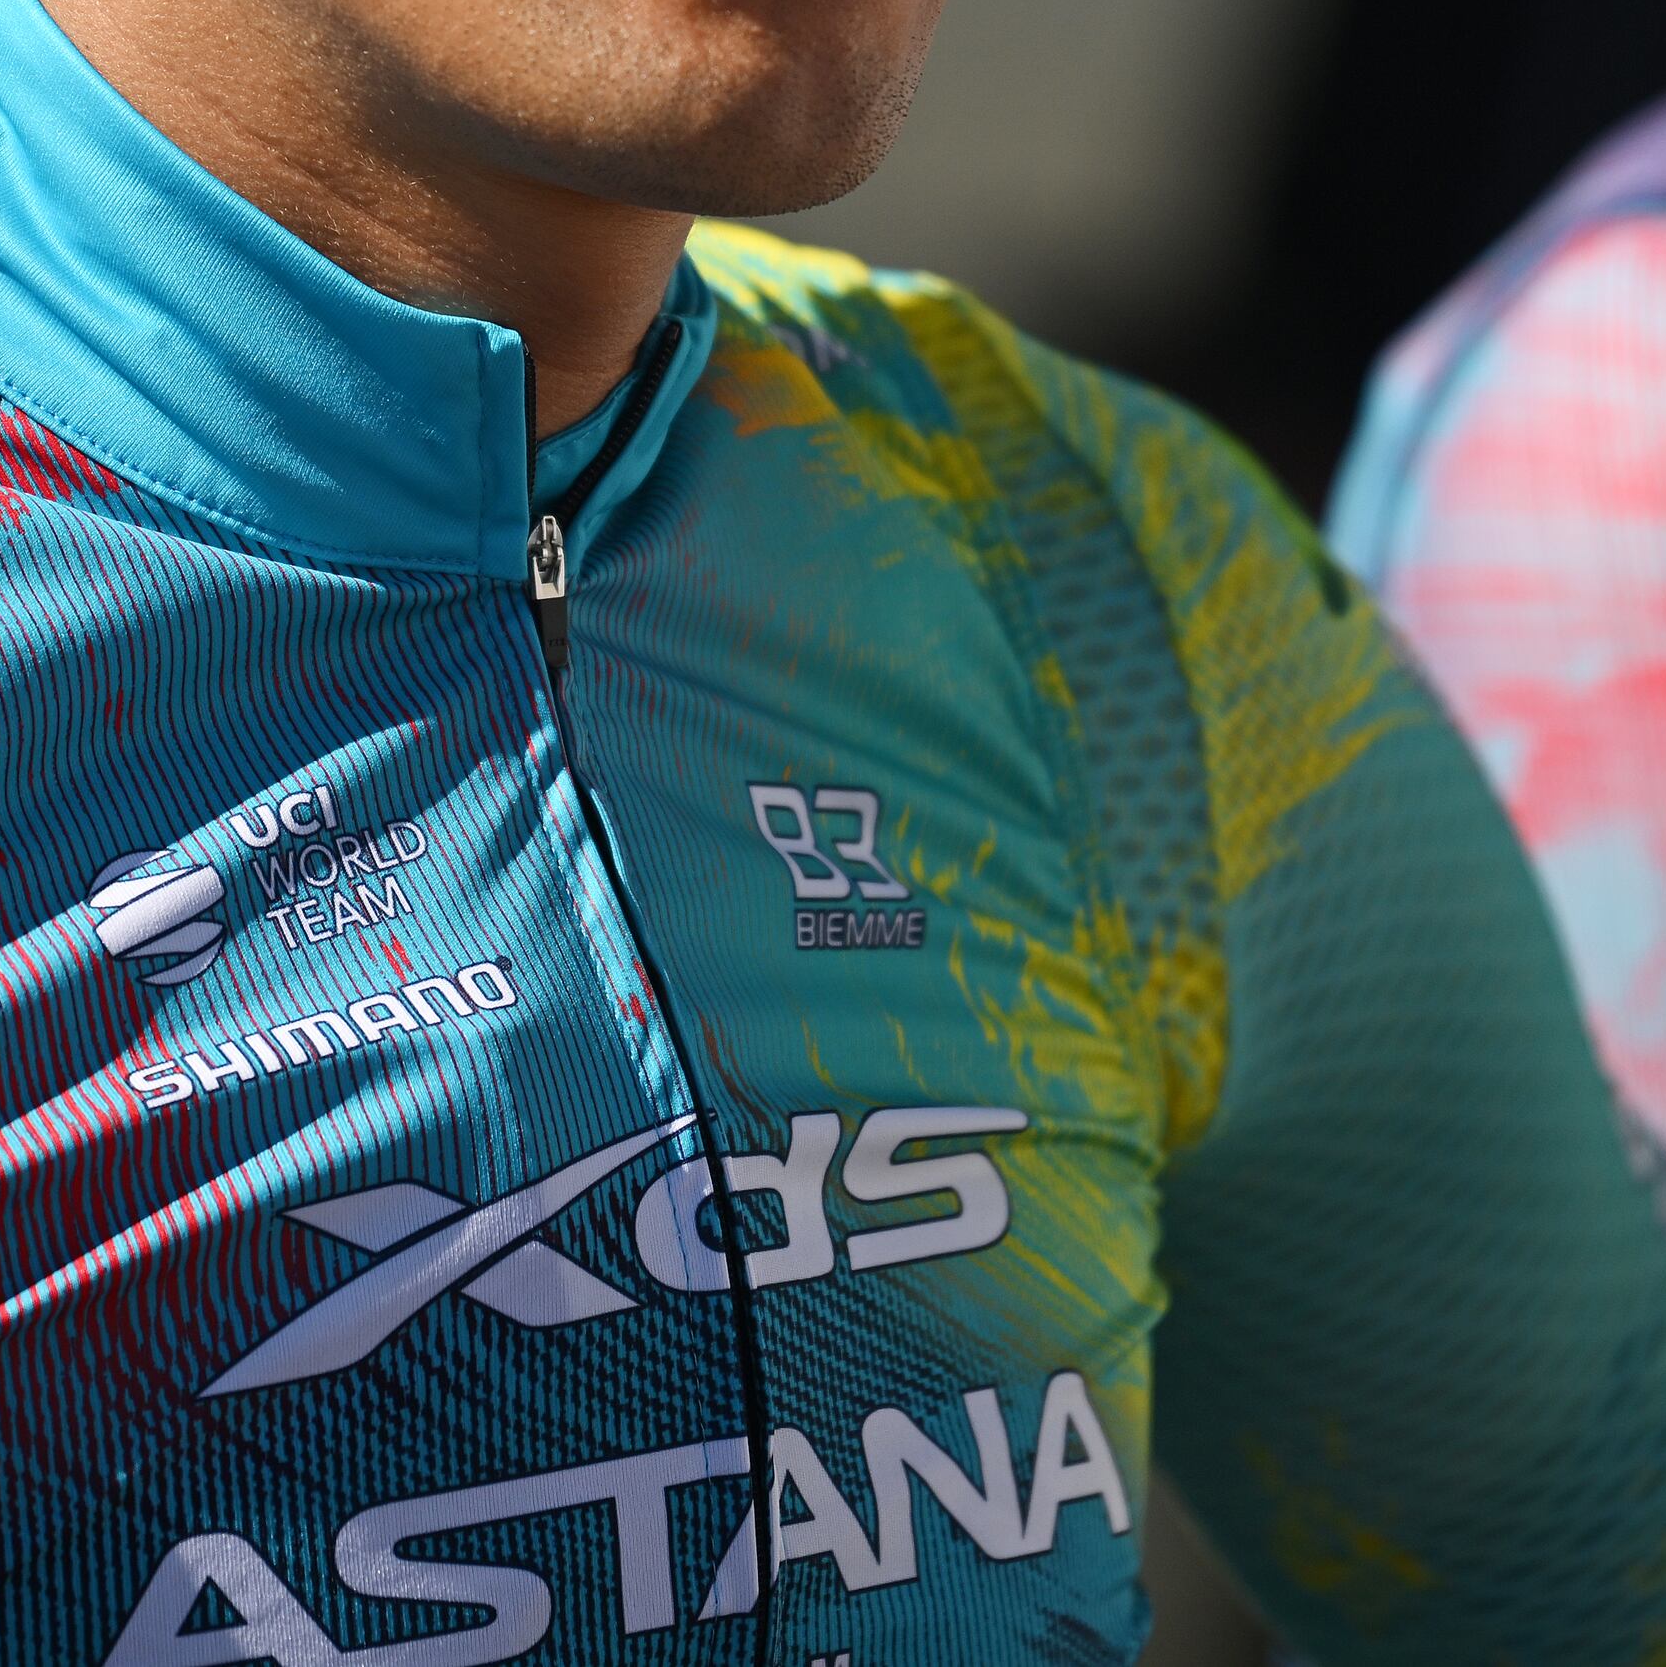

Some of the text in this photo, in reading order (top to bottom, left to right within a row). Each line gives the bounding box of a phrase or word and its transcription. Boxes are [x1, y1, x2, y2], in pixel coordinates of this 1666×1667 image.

[228, 784, 338, 849] UCI
[252, 819, 429, 901] WORLD
[265, 874, 415, 950] TEAM
[795, 908, 926, 950] BIEMME
[99, 1367, 1132, 1667] ASTANA
